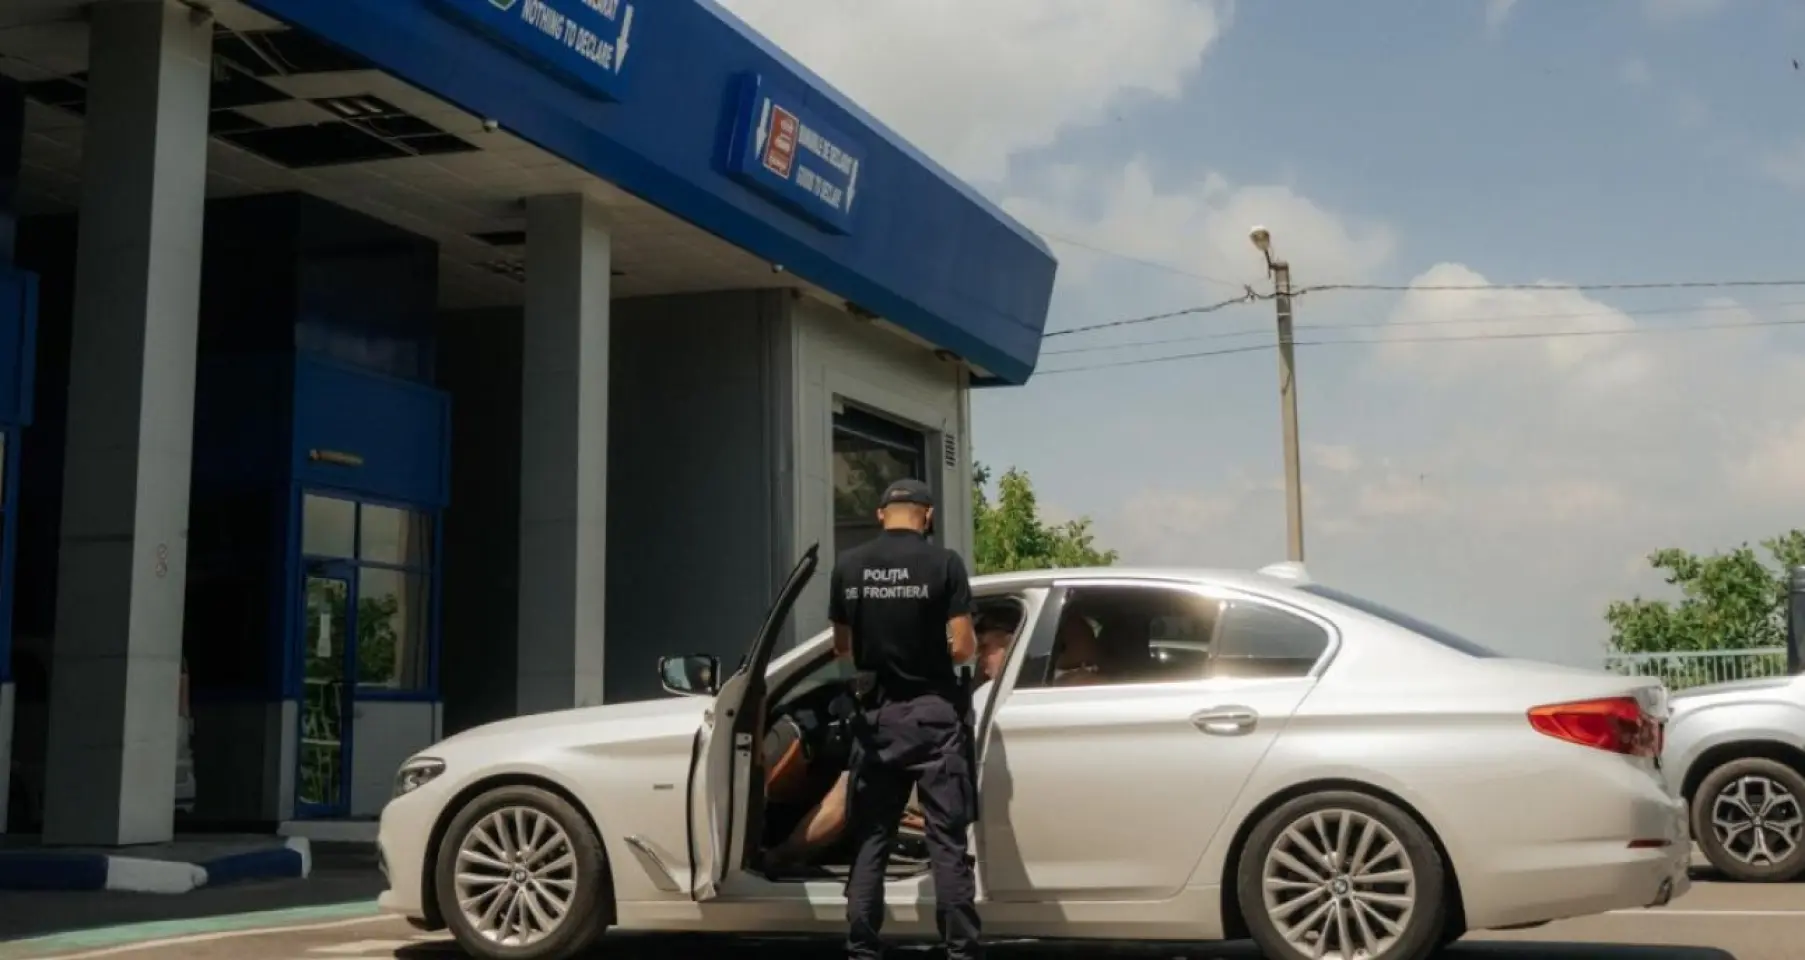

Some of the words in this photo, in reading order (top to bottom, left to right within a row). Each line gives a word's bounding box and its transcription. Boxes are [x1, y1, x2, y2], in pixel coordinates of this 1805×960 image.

[521, 0, 565, 40] NOTHING
[563, 18, 578, 48] TO
[574, 26, 614, 70] DECLARE
